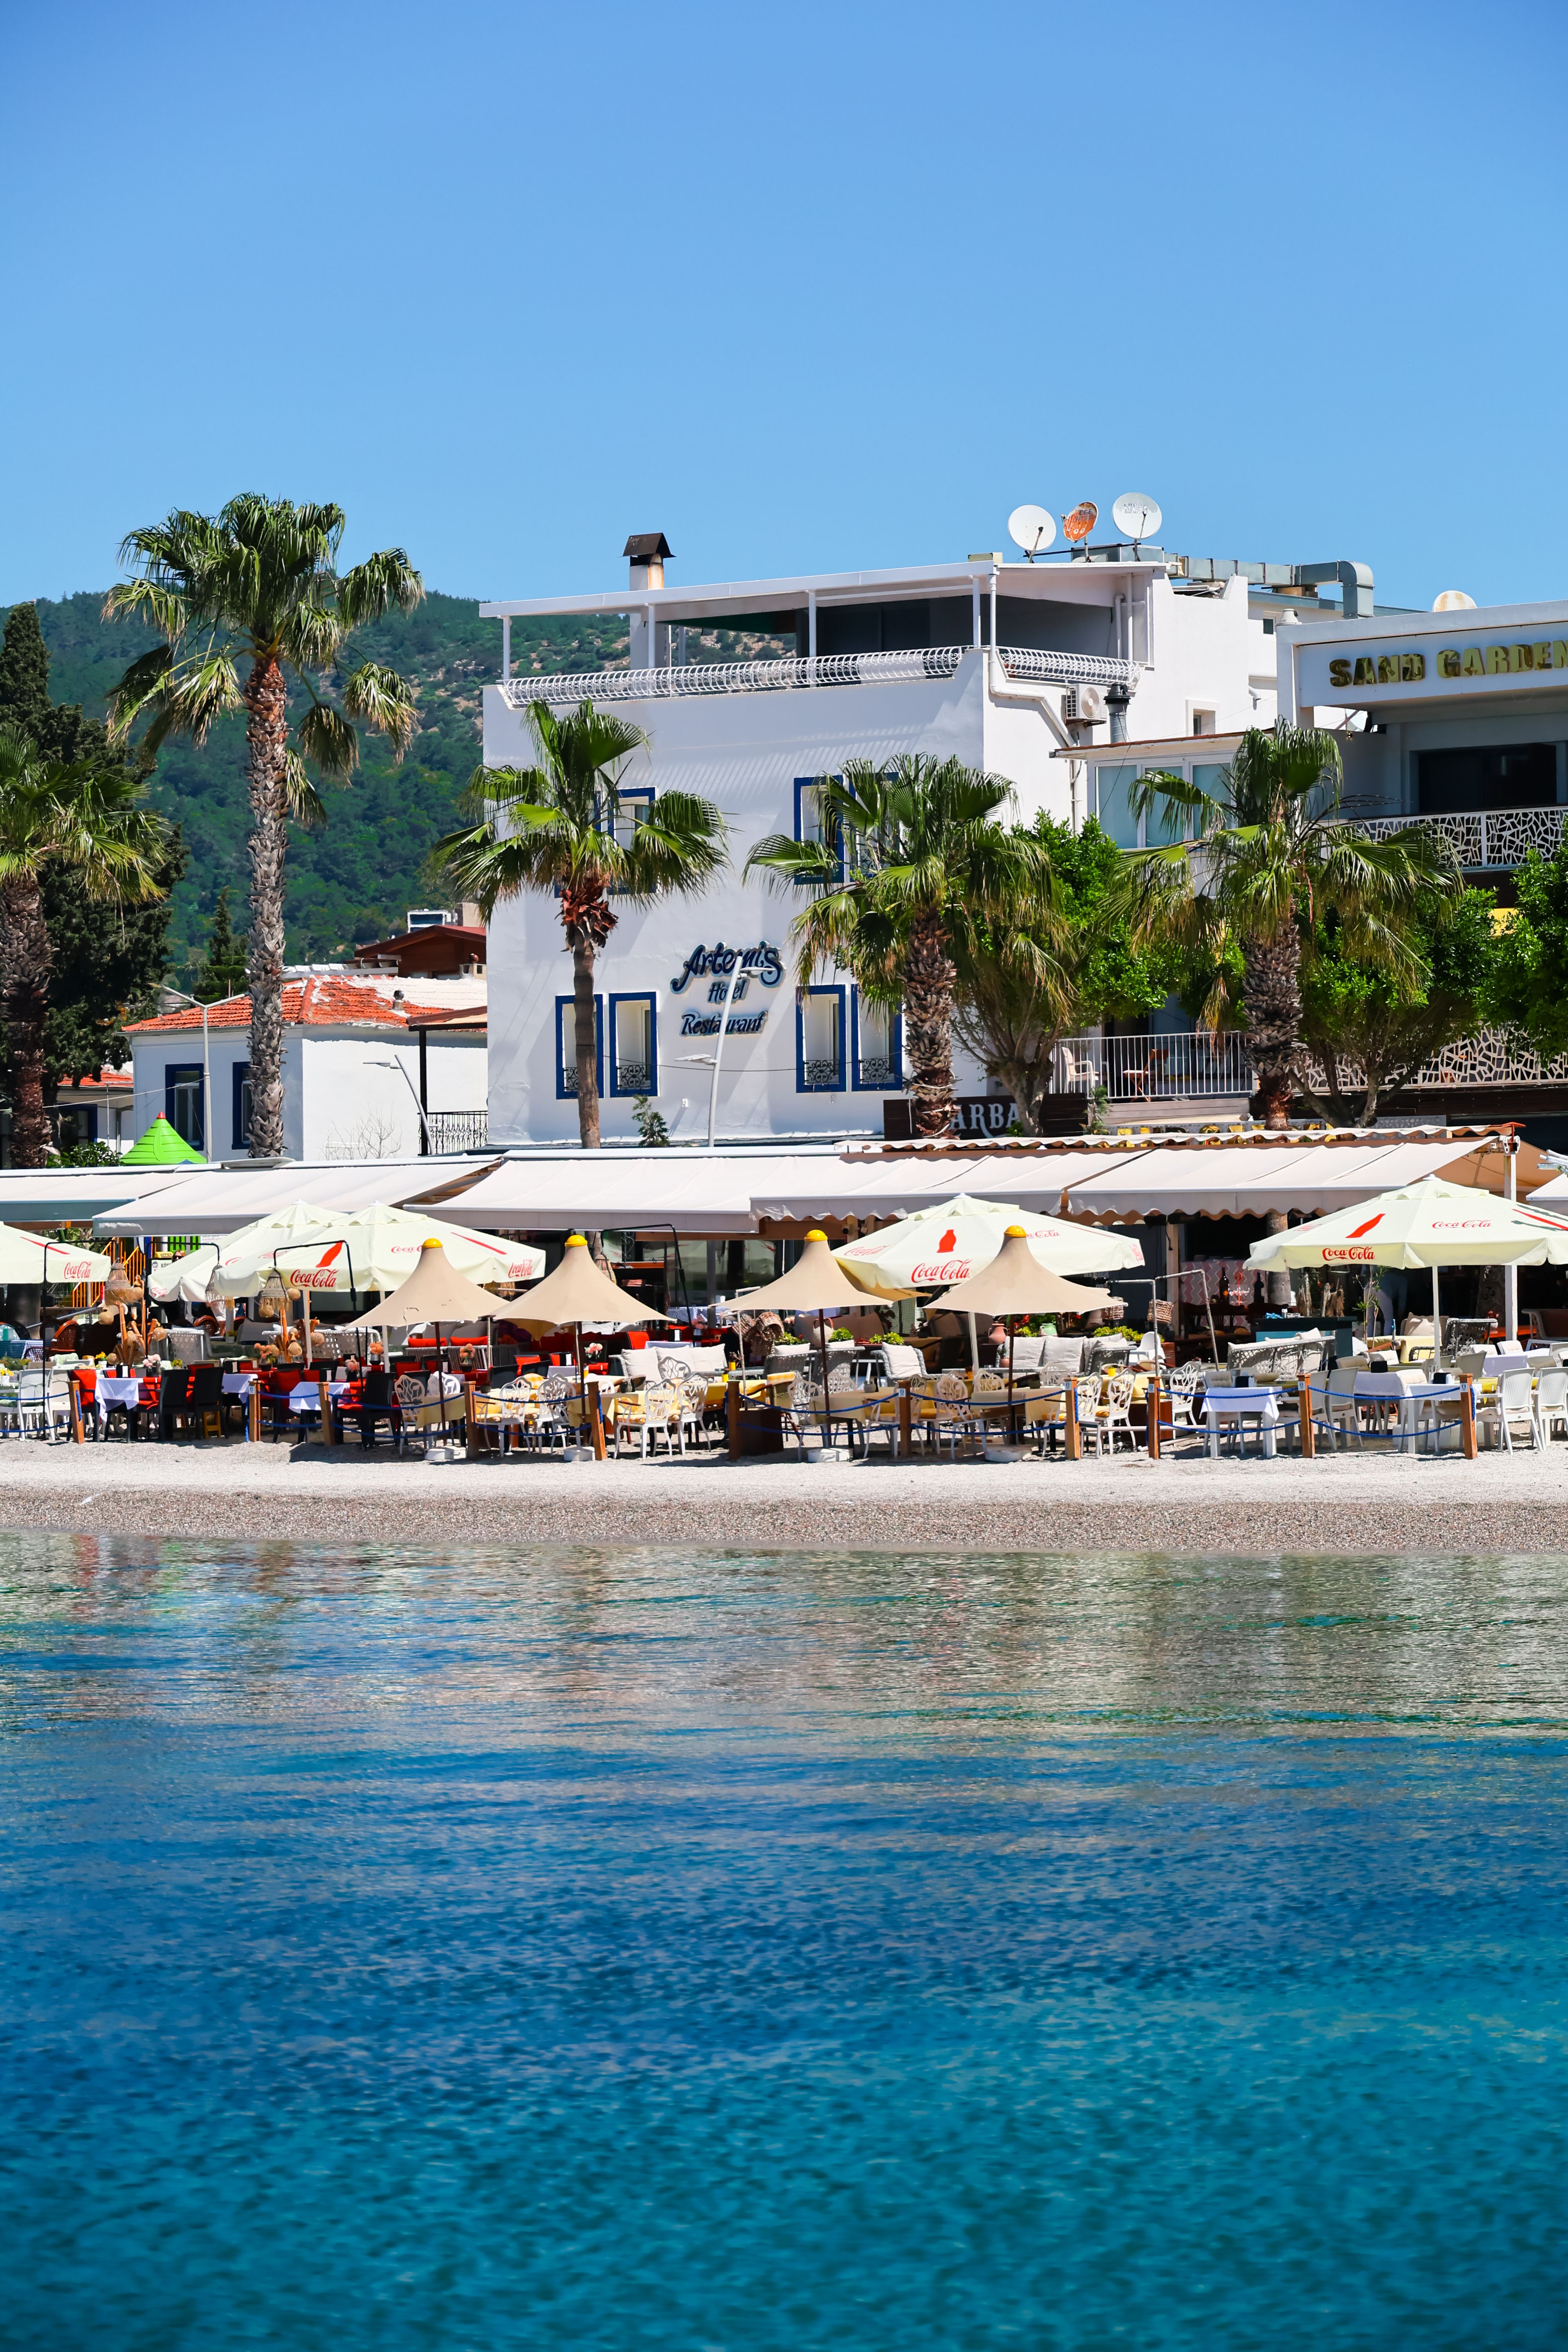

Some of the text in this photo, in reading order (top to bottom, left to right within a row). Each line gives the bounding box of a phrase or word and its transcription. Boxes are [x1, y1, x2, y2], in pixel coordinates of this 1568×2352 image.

[1329, 640, 1568, 687] SAND GARDEN
[672, 942, 782, 992] Artemis
[708, 980, 747, 1003] Hoel
[1432, 1219, 1492, 1229] Coca-Cola
[1026, 1229, 1060, 1239] a-Cola
[1322, 1246, 1376, 1261] Coca-Cola
[64, 1261, 92, 1279] Coca-Cola
[290, 1269, 339, 1288] Coca-Cola
[911, 1259, 973, 1283] Coca-Cola
